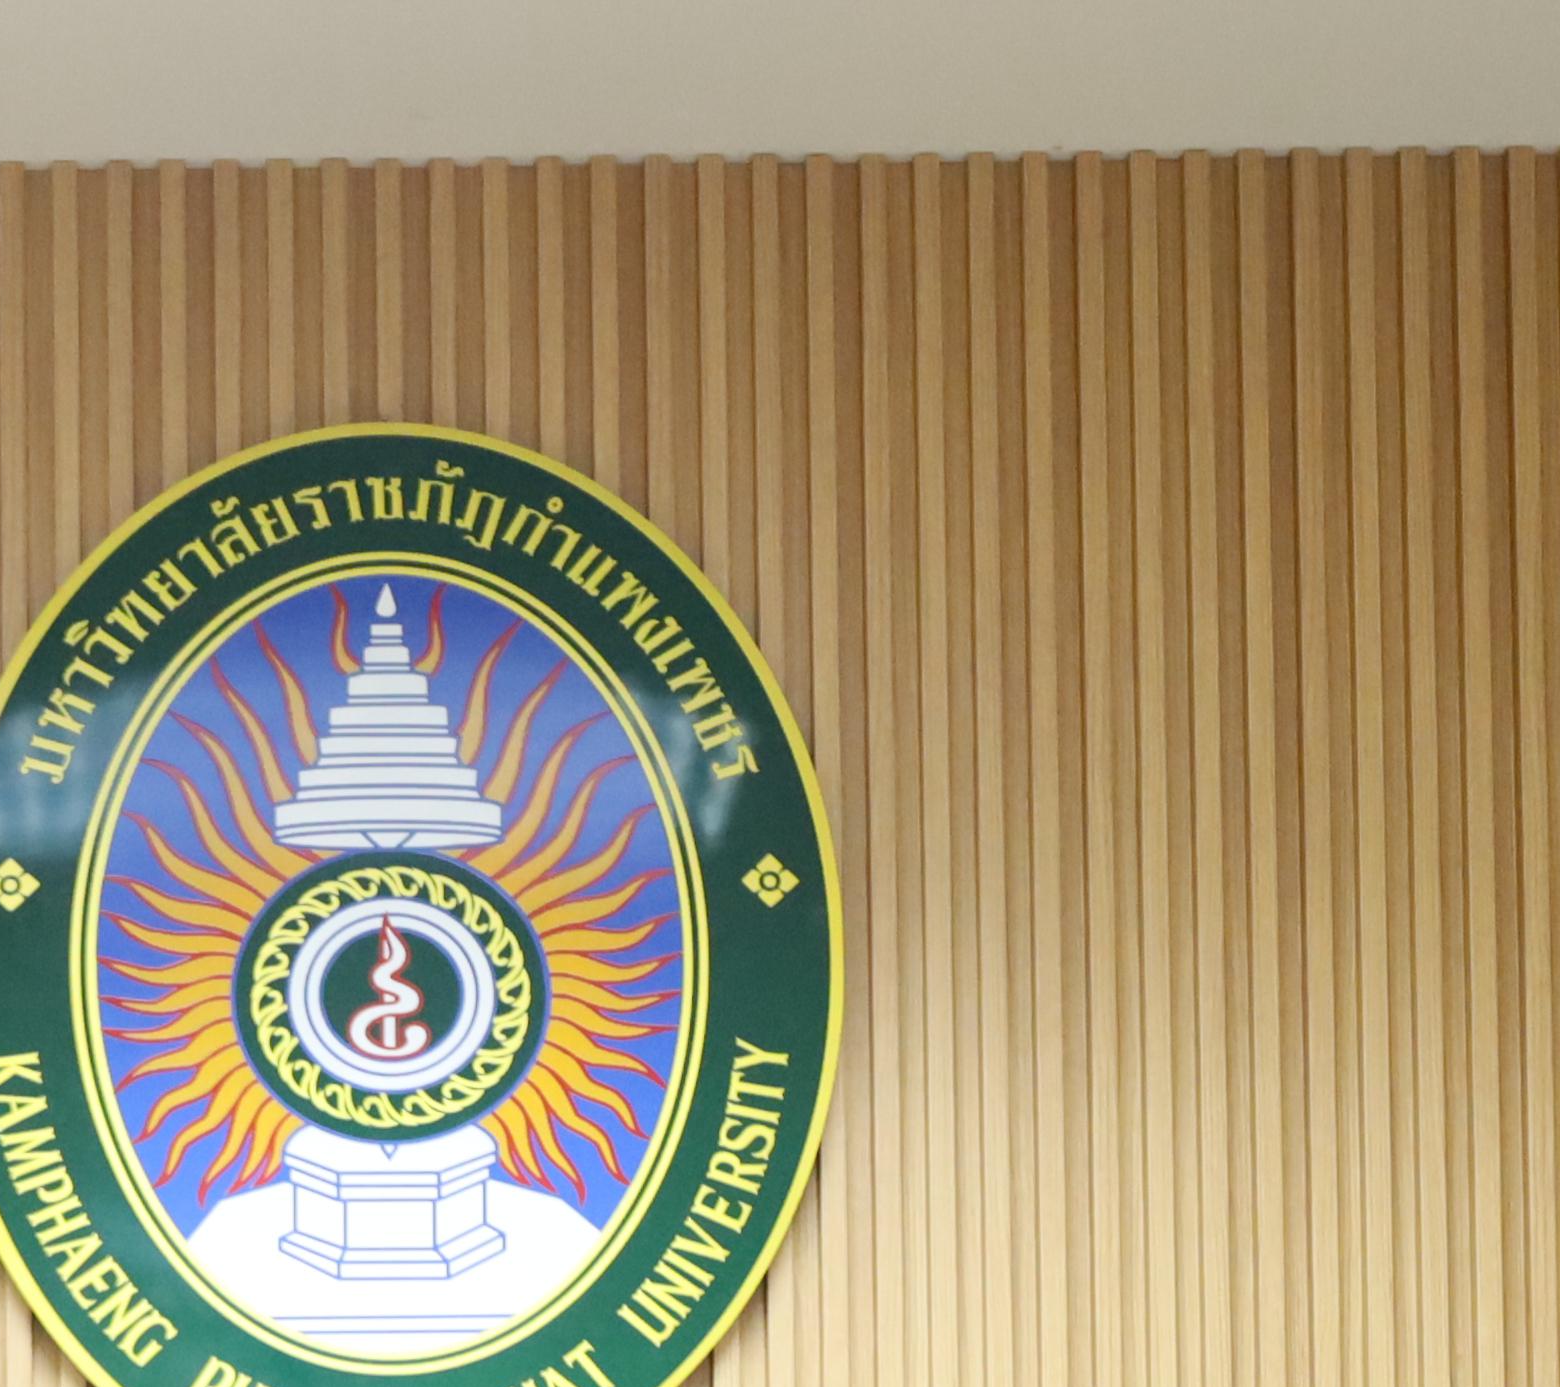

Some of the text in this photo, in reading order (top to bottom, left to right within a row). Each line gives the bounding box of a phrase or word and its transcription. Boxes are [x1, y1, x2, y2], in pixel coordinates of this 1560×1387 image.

[20, 459, 761, 786] มหาวิทยาลัยราชภัฏกำแพงเพชร
[616, 1036, 792, 1349] UNIVERSITY
